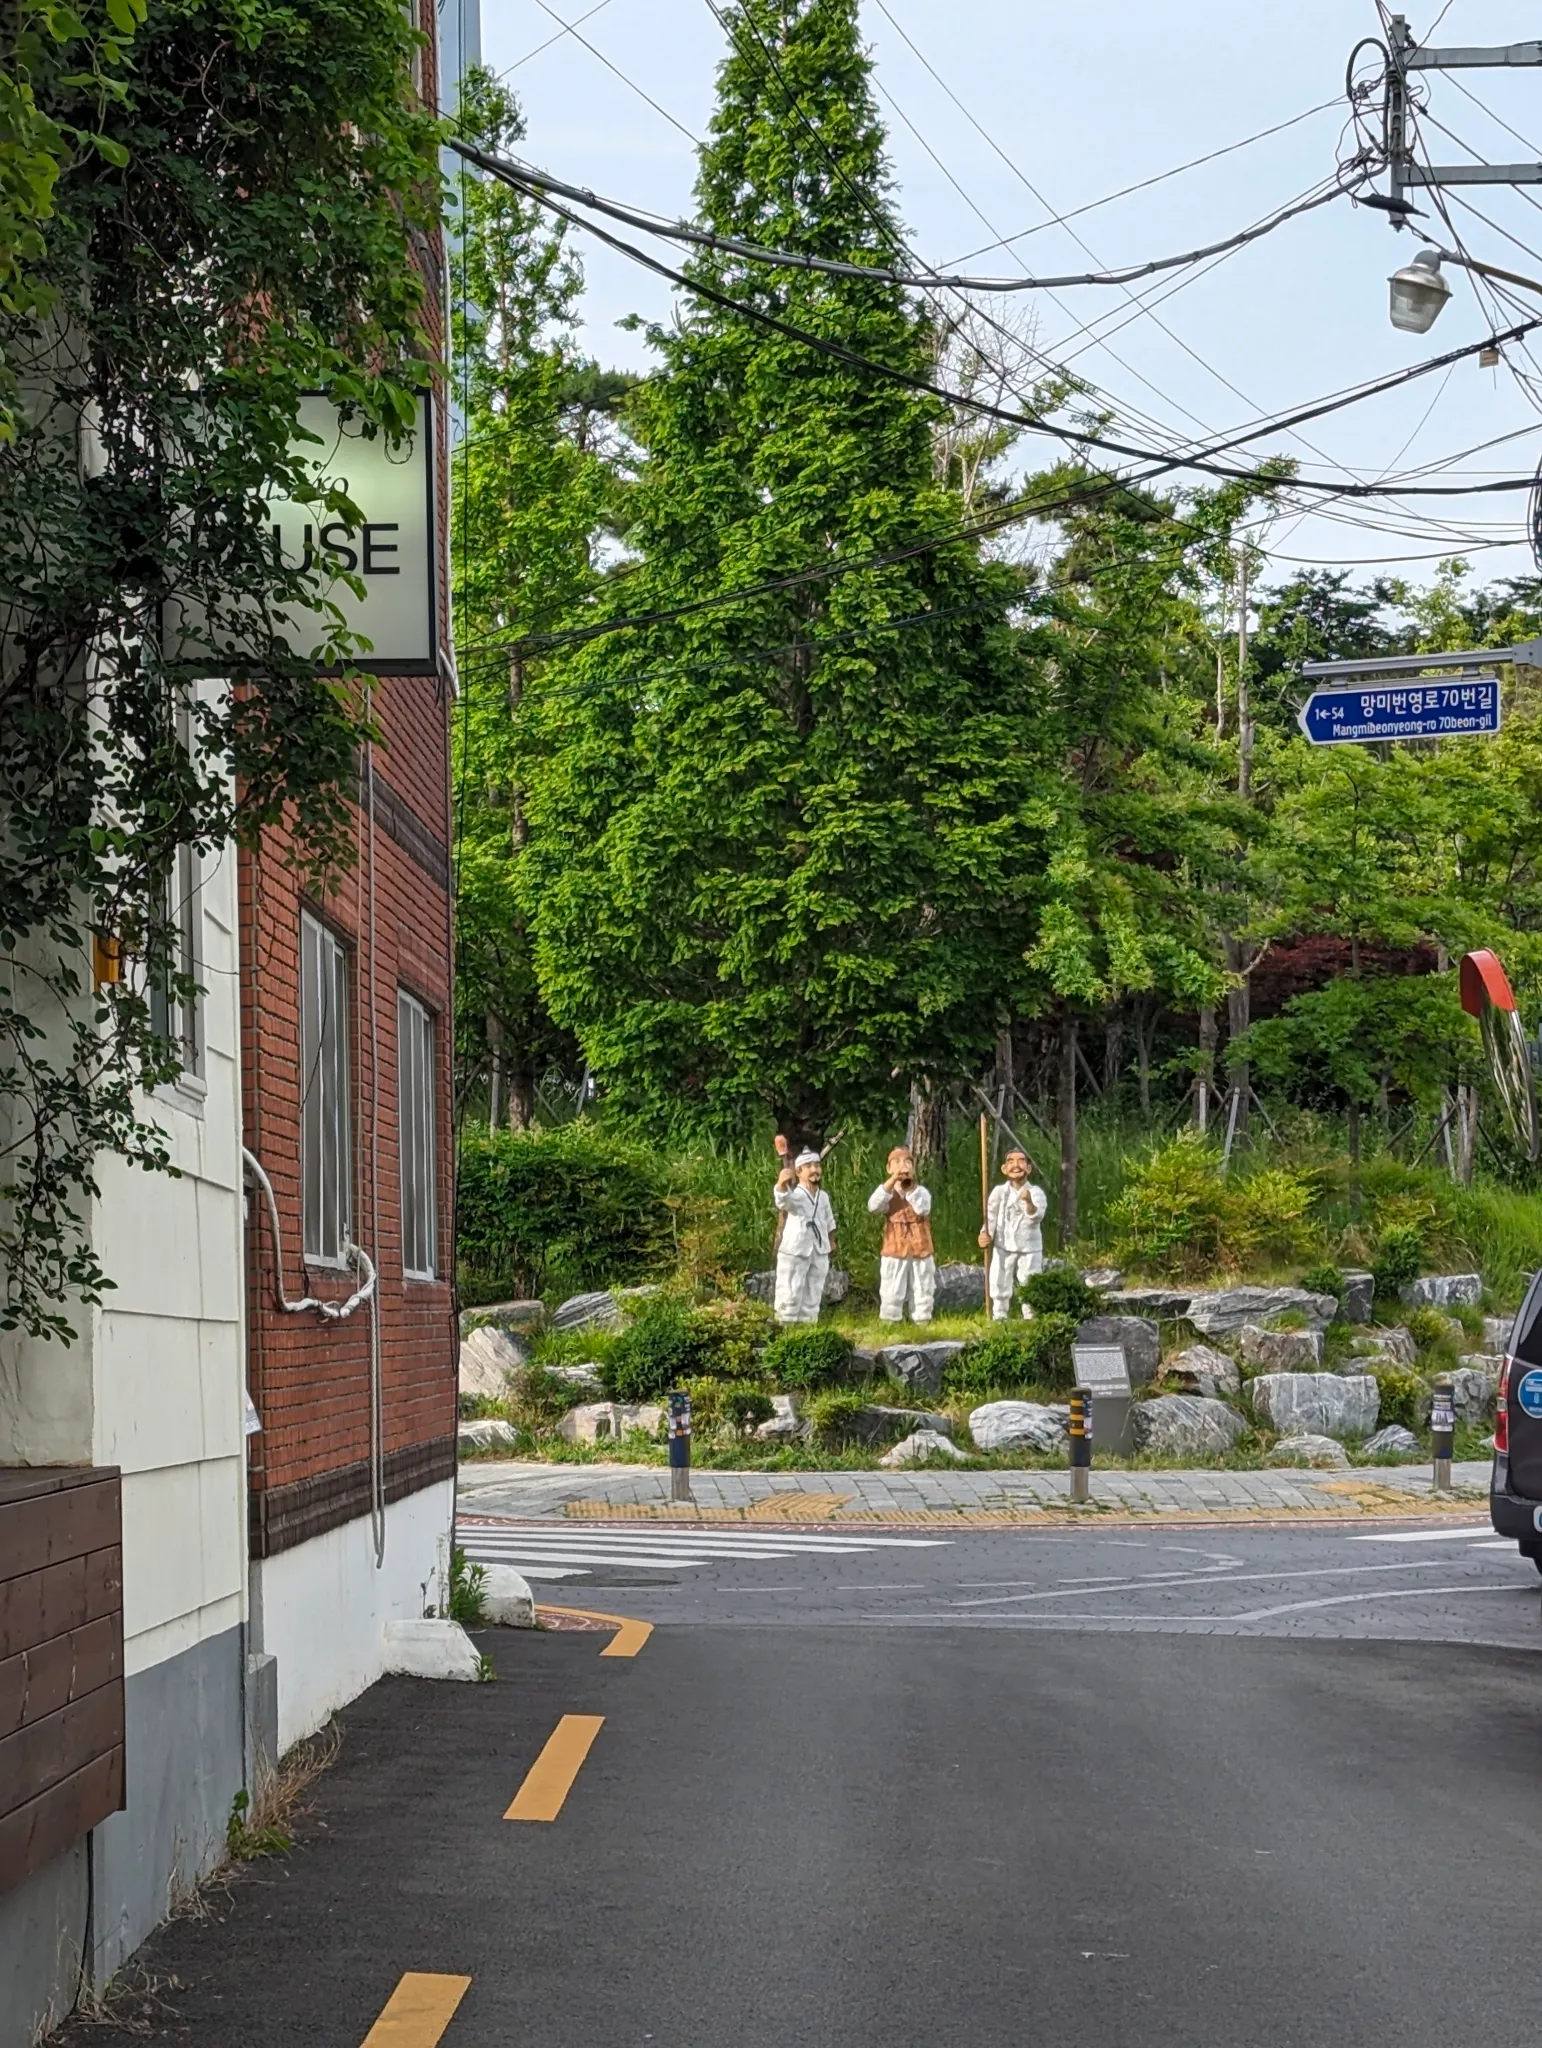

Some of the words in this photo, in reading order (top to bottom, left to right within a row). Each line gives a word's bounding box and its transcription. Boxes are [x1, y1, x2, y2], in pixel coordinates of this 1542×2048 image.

[1360, 685, 1492, 718] 망미번영로70번길
[1332, 719, 1437, 738] Mangmibeonyeong-ro
[1438, 713, 1492, 731] 70beon-gil
